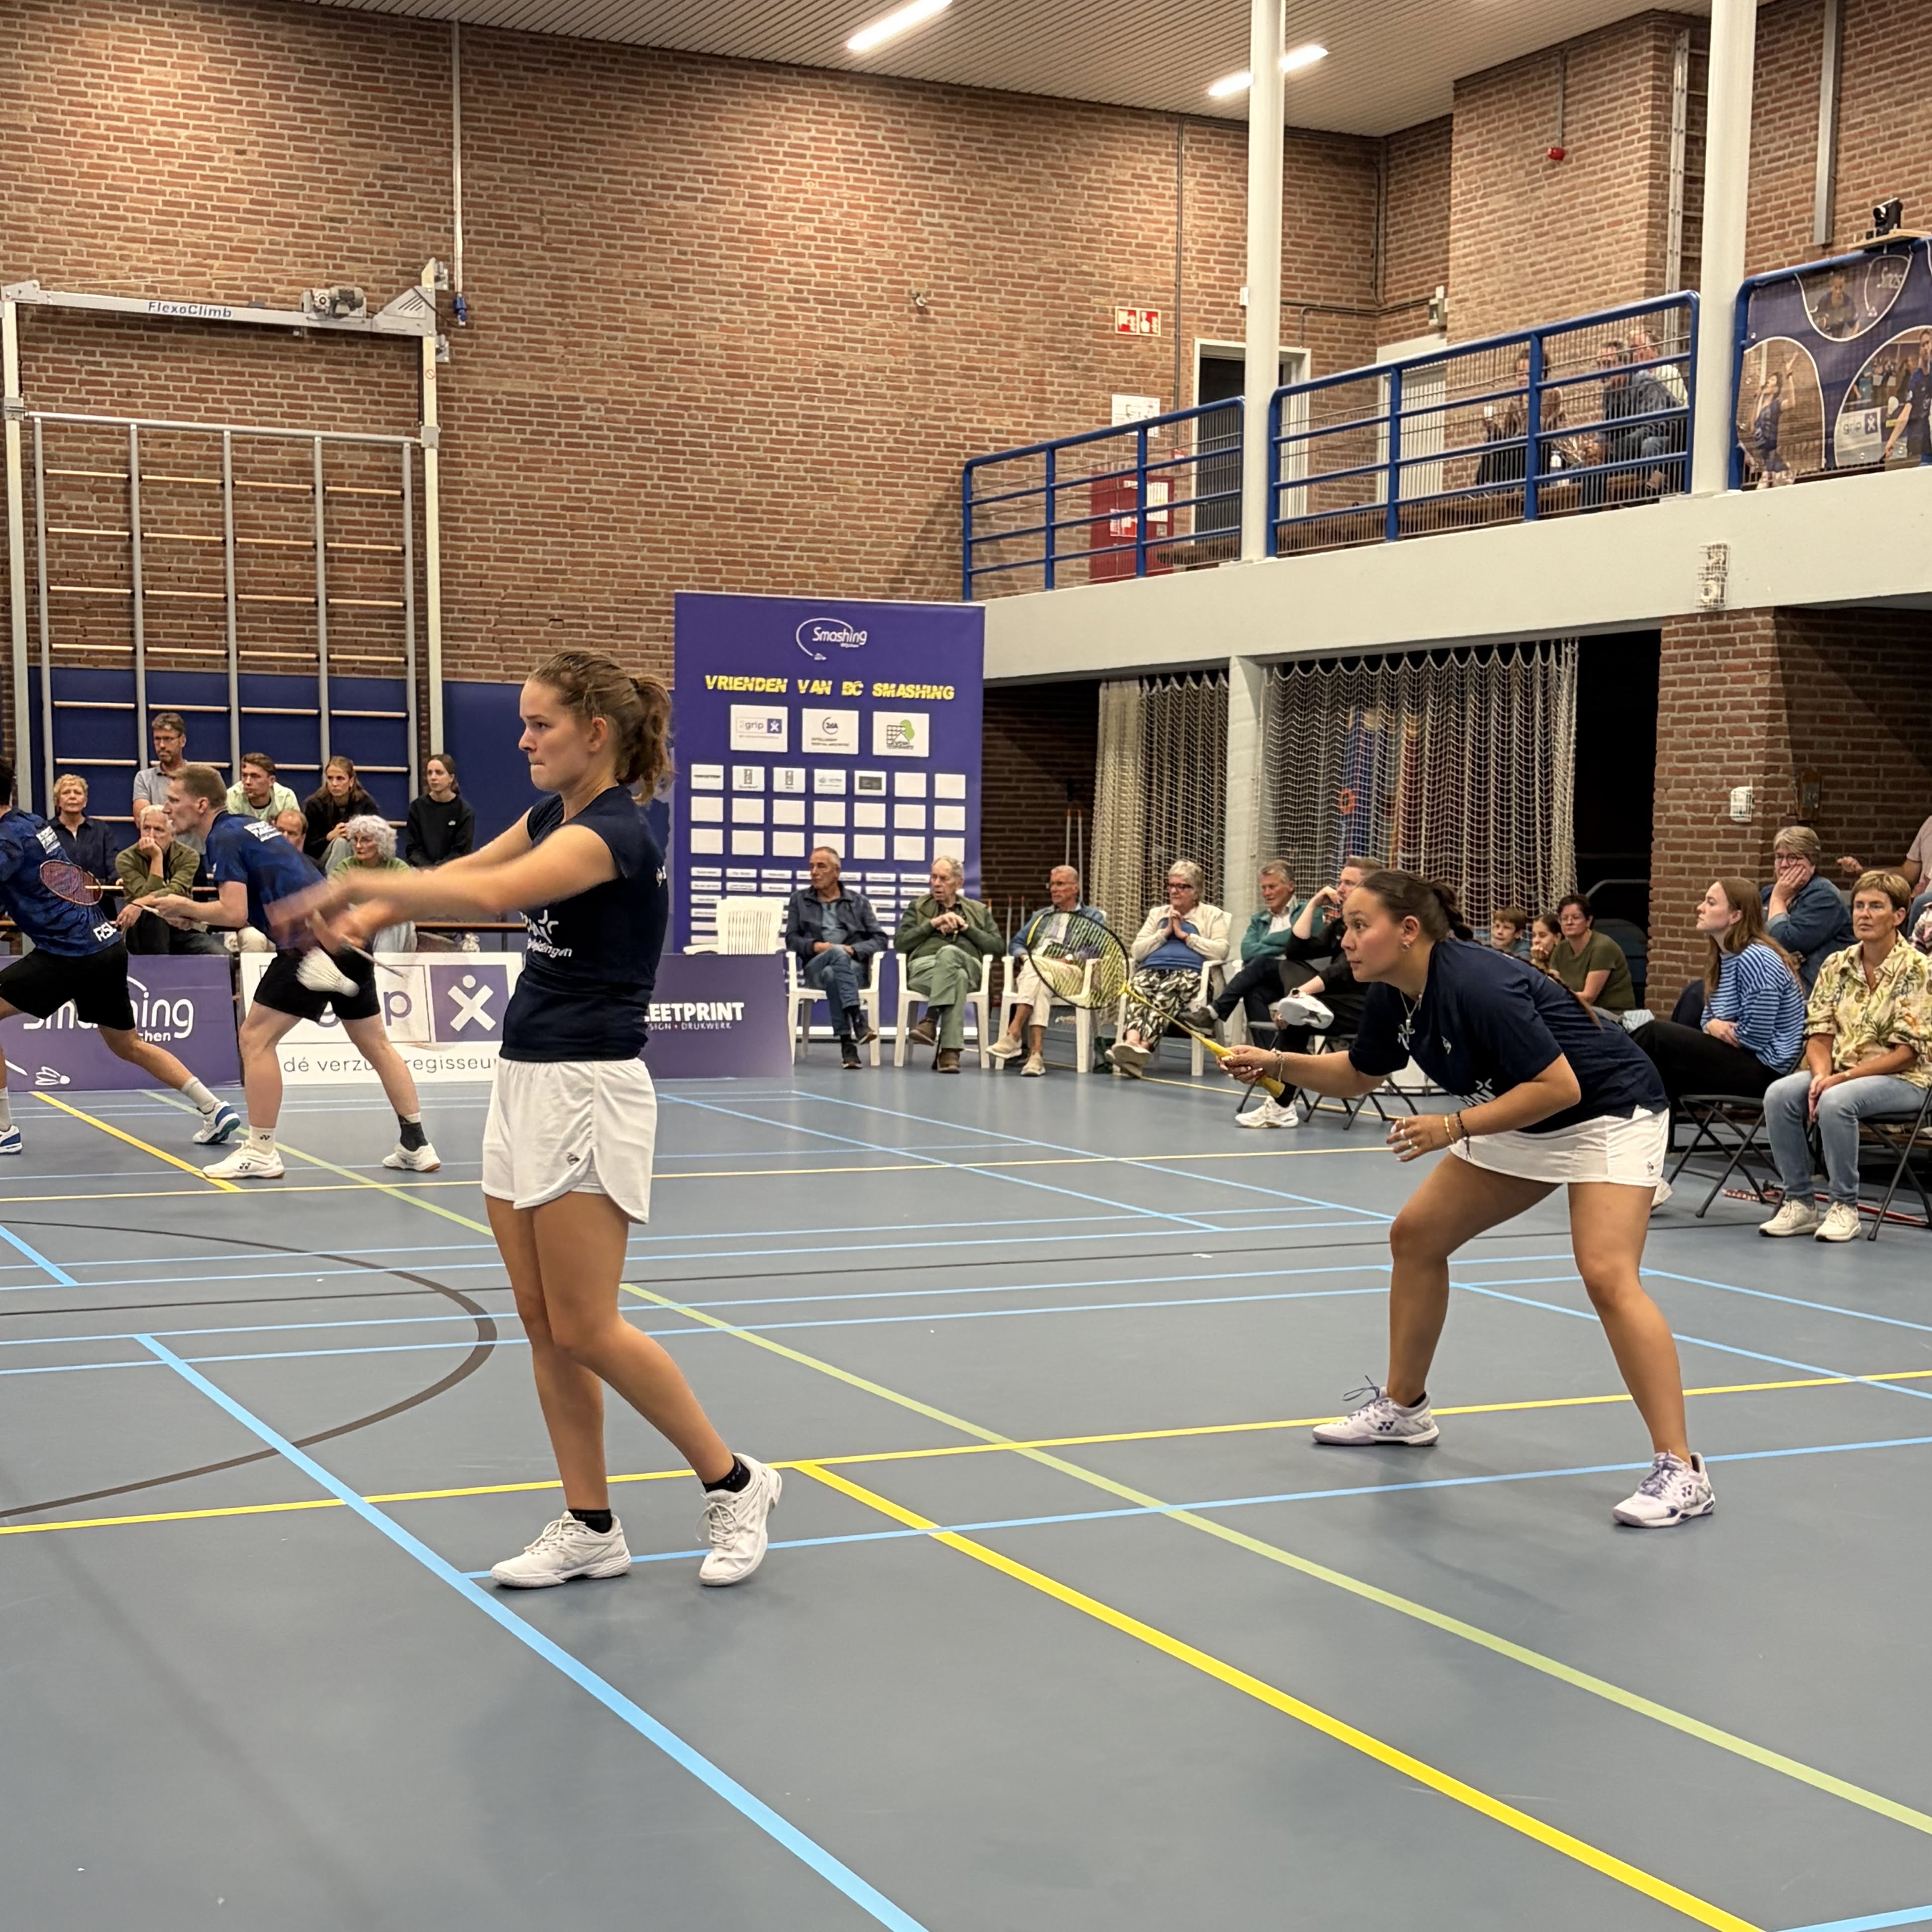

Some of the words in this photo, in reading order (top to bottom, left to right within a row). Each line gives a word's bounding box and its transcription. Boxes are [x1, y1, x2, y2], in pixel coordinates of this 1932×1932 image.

[148, 302, 231, 317] FlexoClimb
[812, 627, 867, 645] Smashing
[705, 675, 788, 693] VRIENDEN
[798, 680, 832, 695] VAN
[841, 681, 863, 696] BC
[872, 683, 954, 701] SMASHING
[644, 1002, 745, 1022] EETPRINT
[284, 1057, 309, 1072] dé
